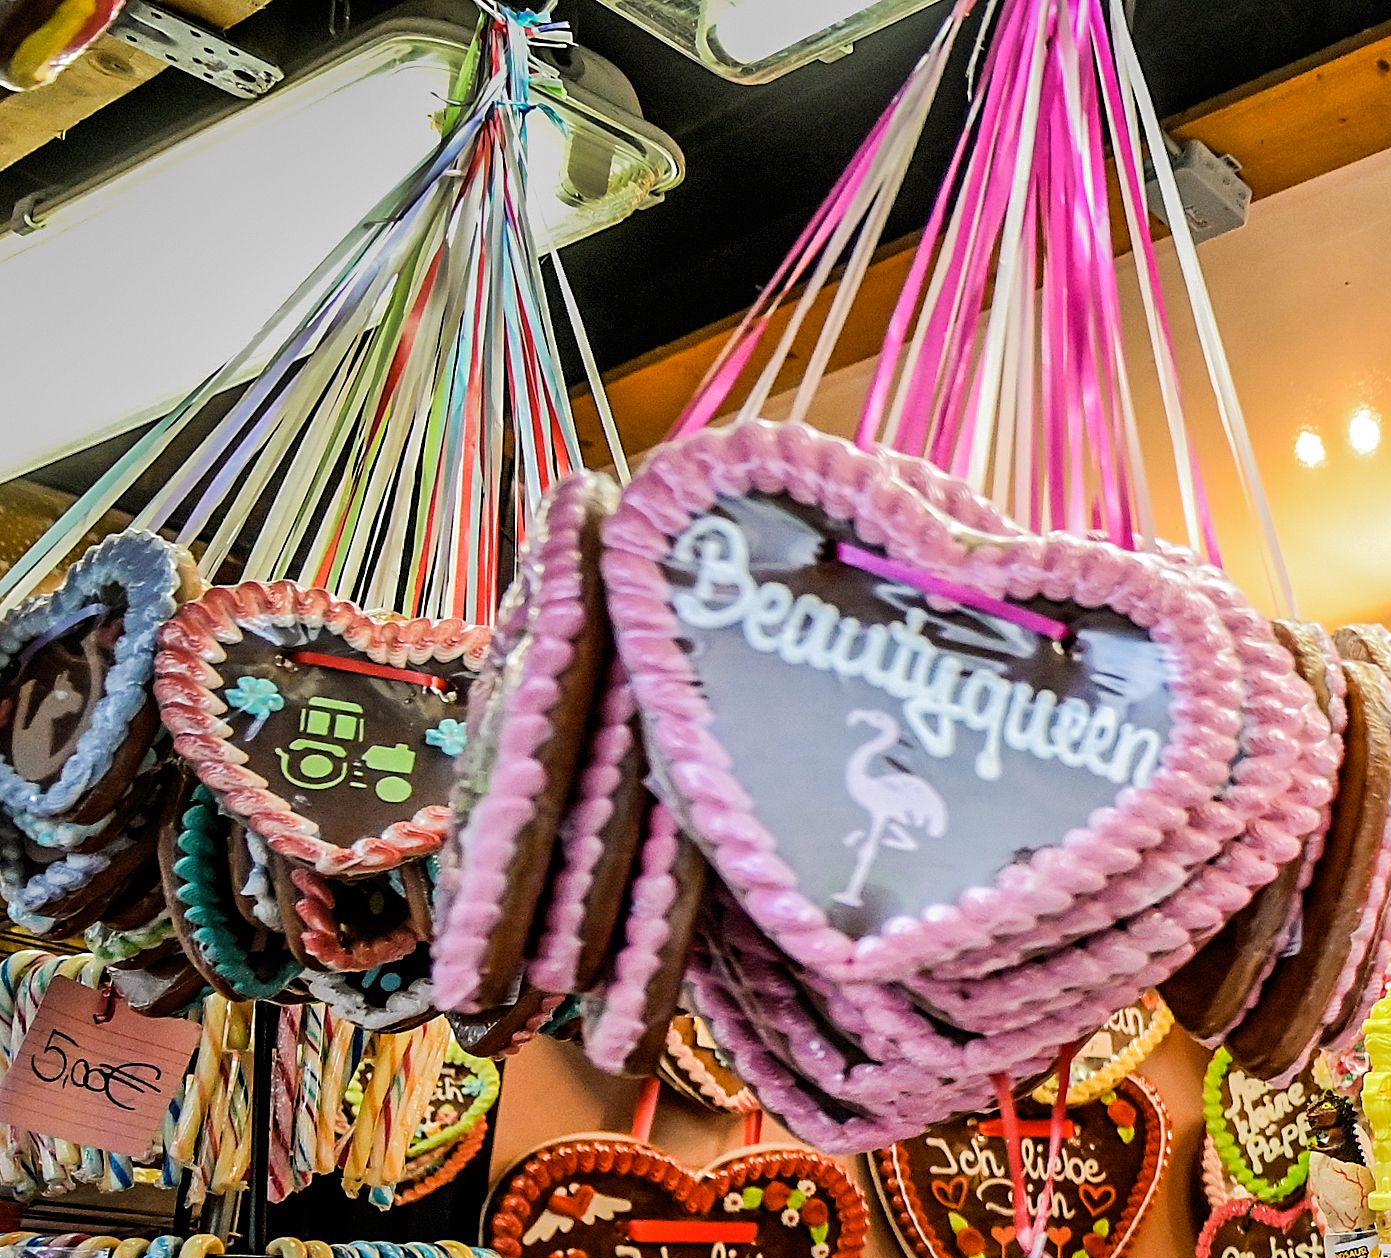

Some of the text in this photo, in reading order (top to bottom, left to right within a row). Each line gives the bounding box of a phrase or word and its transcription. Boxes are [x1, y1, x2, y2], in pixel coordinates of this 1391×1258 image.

[673, 516, 1163, 787] Beautyqueen
[31, 1028, 162, 1111] 5,00€
[925, 1136, 1107, 1185] Ich liebe
[975, 1177, 1077, 1220] Dih
